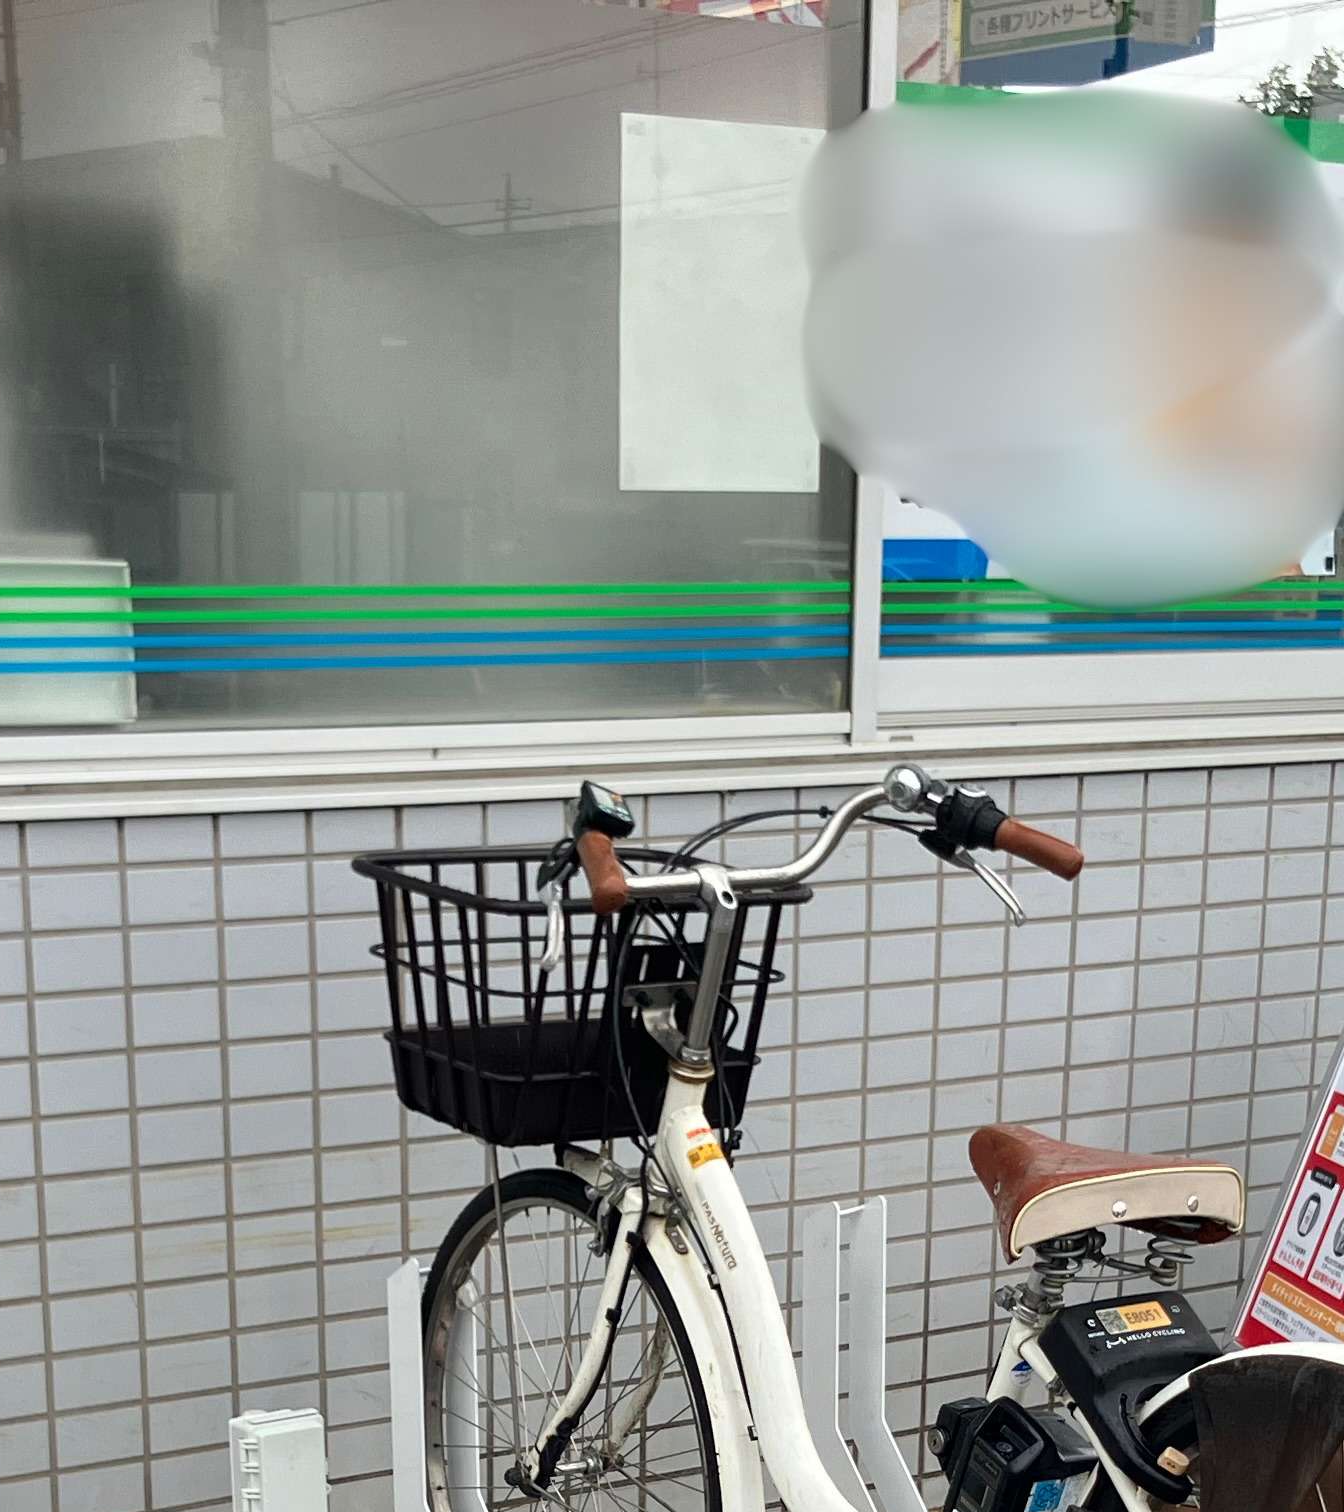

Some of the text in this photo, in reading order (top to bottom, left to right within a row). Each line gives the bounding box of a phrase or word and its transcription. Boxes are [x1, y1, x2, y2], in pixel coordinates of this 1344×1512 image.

[1124, 1308, 1162, 1325] E8051
[1126, 1327, 1186, 1342] HELLO CYCLING
